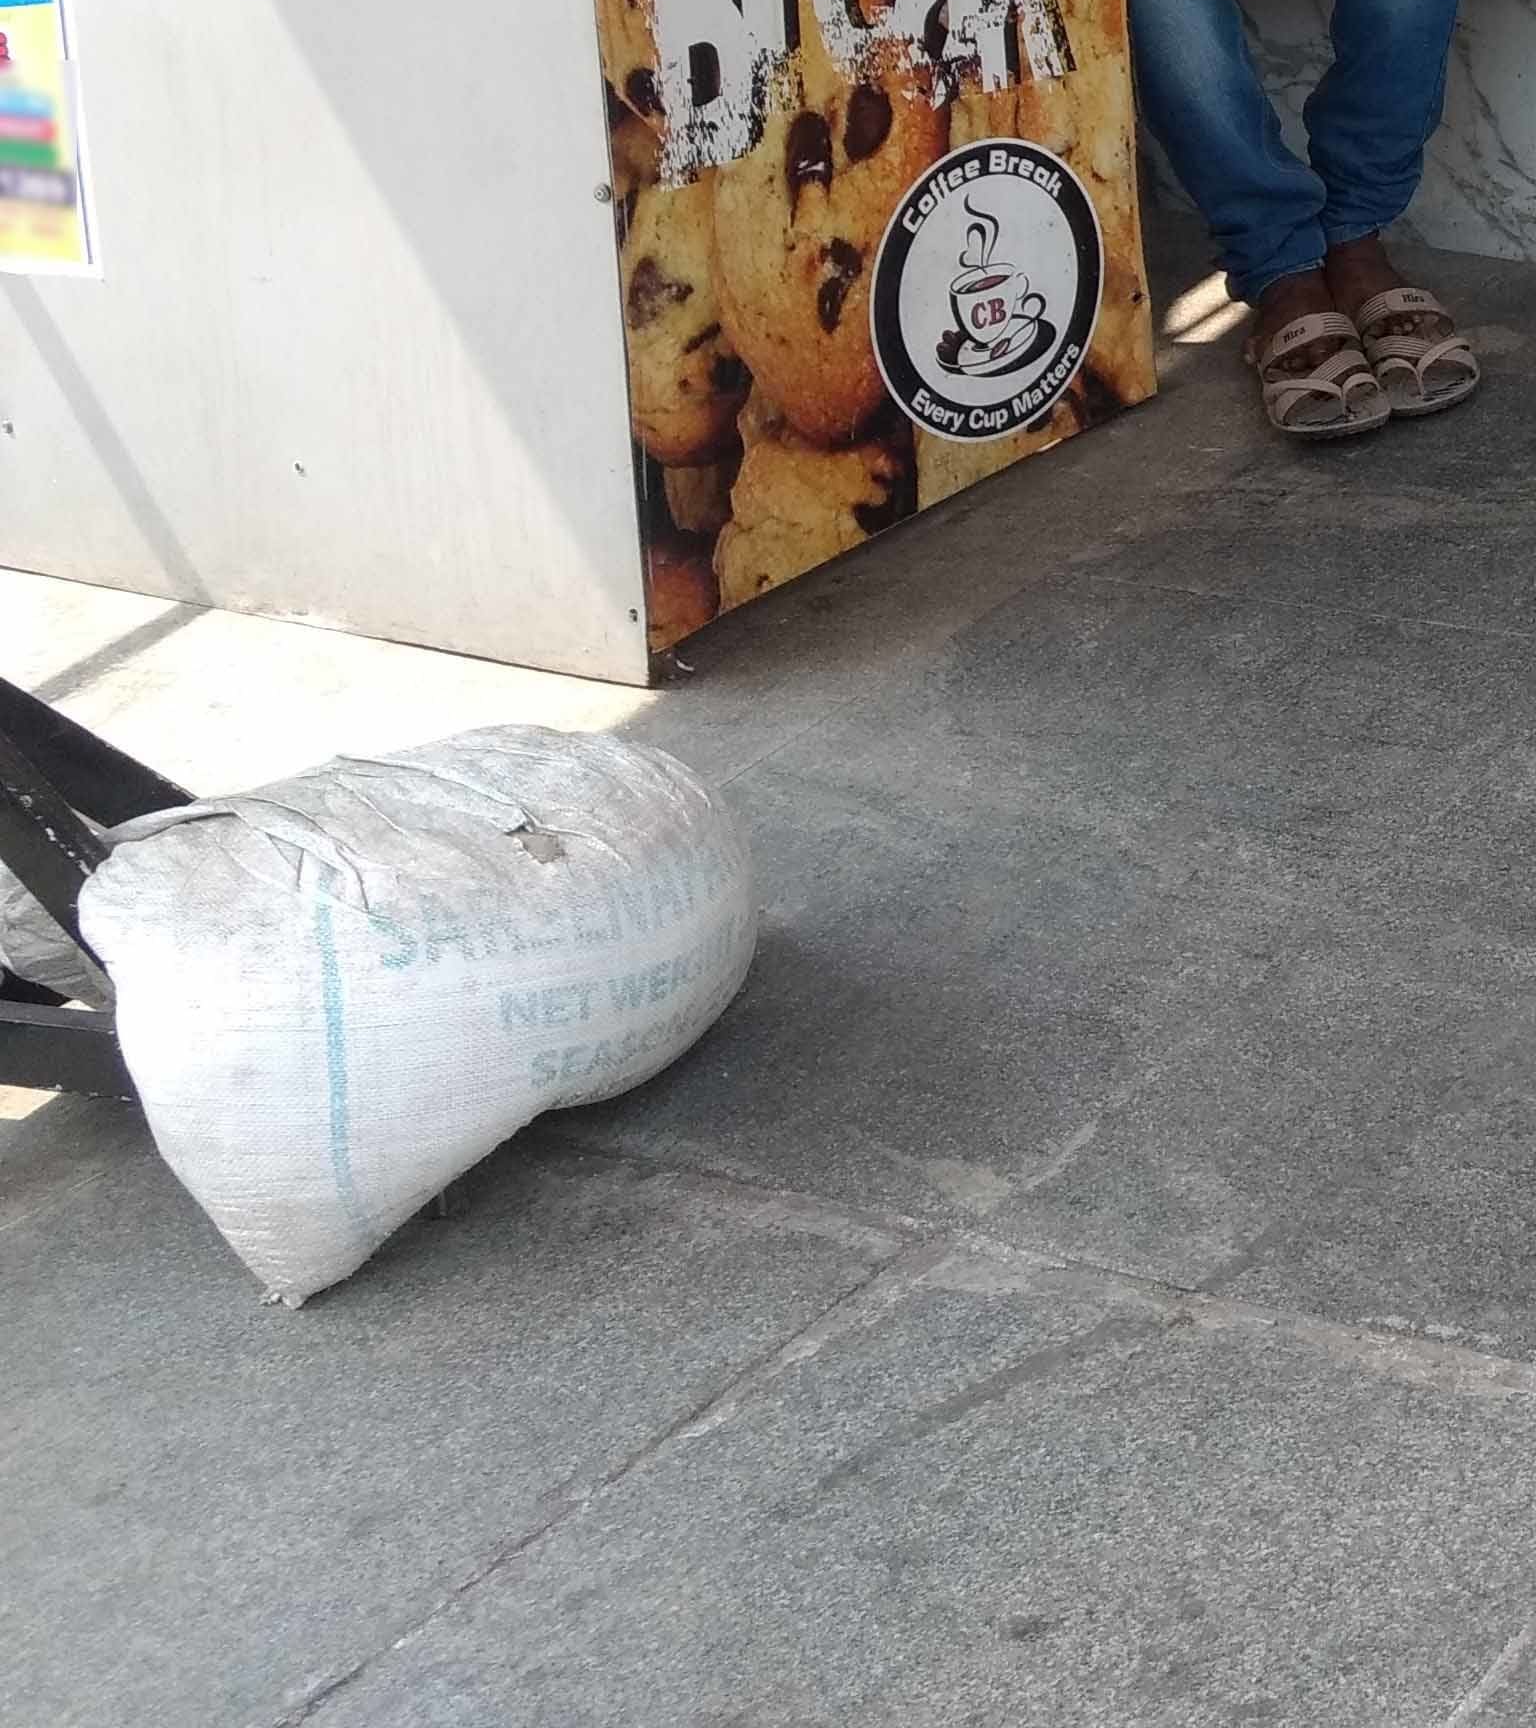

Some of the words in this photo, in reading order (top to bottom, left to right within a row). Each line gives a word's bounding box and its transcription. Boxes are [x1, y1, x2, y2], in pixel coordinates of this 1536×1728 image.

[903, 159, 980, 234] Coffee
[989, 150, 1063, 196] Break
[971, 297, 1006, 329] CB
[911, 389, 964, 432] Every
[969, 408, 1008, 430] Cup
[1012, 343, 1080, 417] Matters
